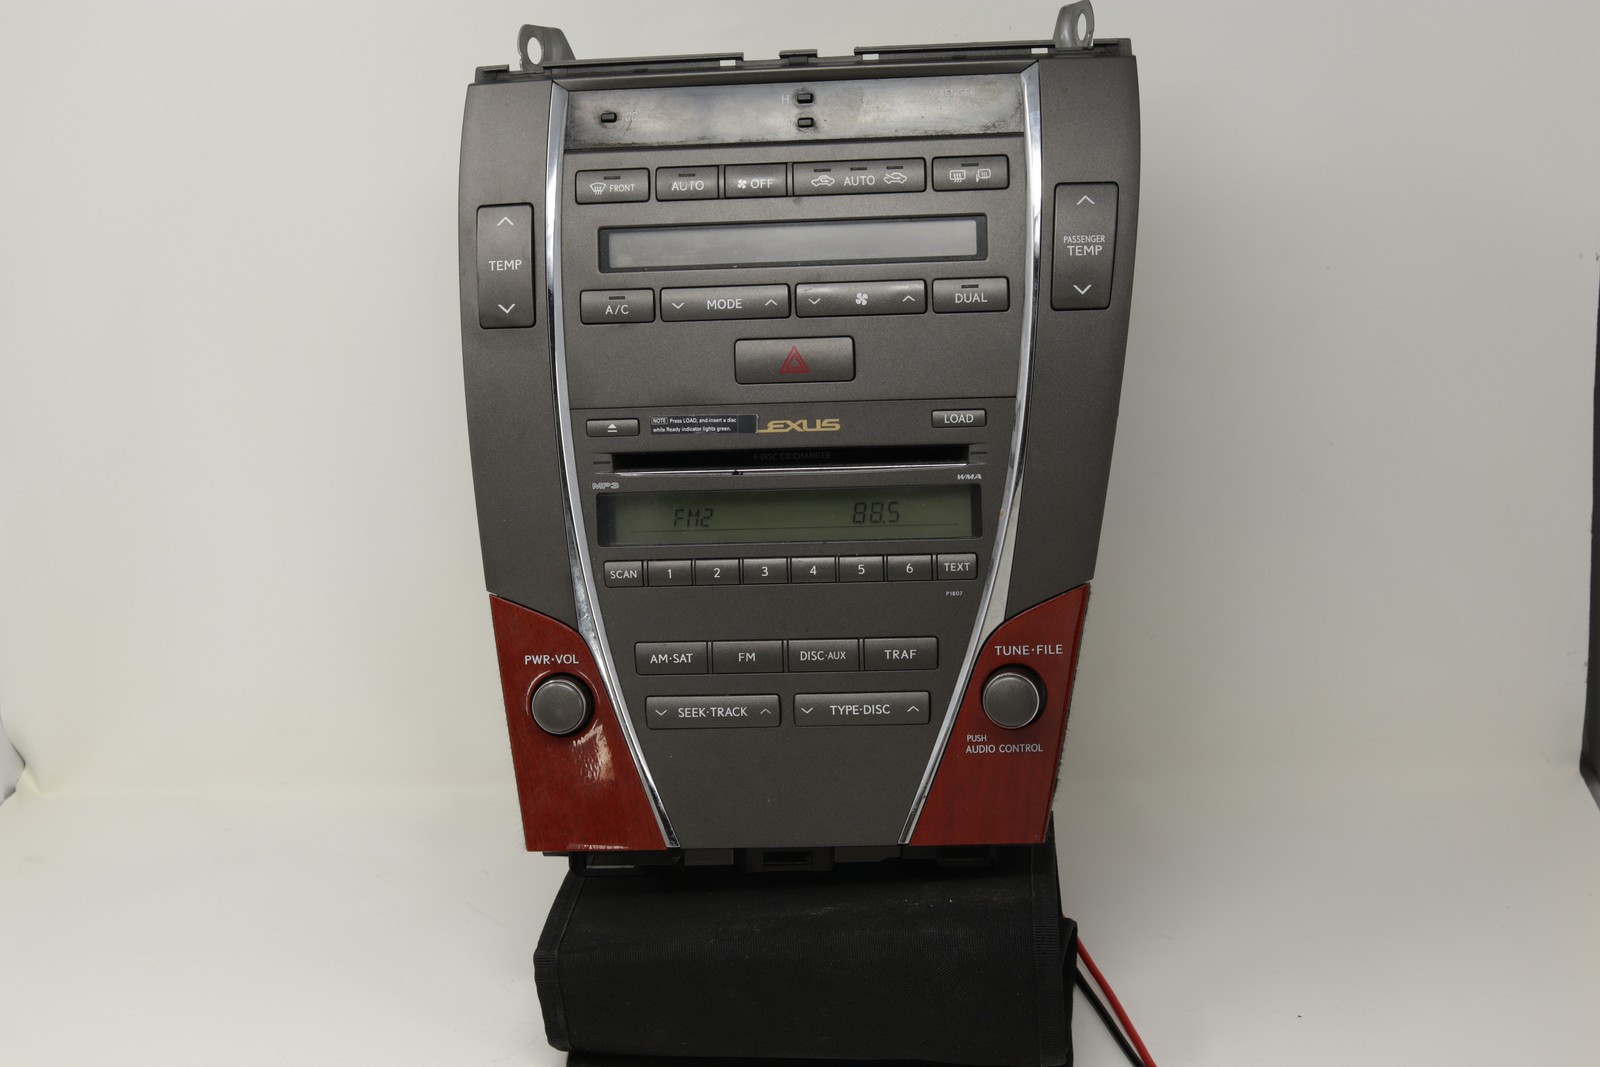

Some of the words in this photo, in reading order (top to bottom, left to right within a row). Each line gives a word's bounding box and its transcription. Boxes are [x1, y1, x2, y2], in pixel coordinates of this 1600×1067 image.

[671, 180, 705, 191] AUTO
[750, 178, 774, 189] OFF
[843, 175, 876, 187] AUTO
[609, 183, 635, 193] FRONT
[1063, 235, 1105, 244] PASSENGER
[1067, 245, 1103, 256] TEMP
[488, 259, 522, 271] TEMP
[954, 292, 988, 304] DUAL
[605, 304, 629, 315] A/C
[706, 298, 743, 310] MODE
[944, 413, 974, 424] LOAD
[592, 482, 620, 490] MP3
[673, 508, 714, 528] FM2
[852, 501, 900, 524] 88.5
[761, 566, 769, 577] 3
[809, 565, 817, 575] 4
[857, 564, 865, 575] 5
[905, 563, 914, 574] 6
[943, 562, 971, 572] TEXT
[610, 569, 637, 579] SCAN
[667, 569, 672, 578] 1
[713, 568, 721, 578] 2
[738, 652, 756, 662] FM
[884, 649, 917, 660] TRAF
[966, 734, 987, 742] PUSH
[965, 744, 996, 754] AUDIO
[998, 743, 1043, 753] CONTROL
